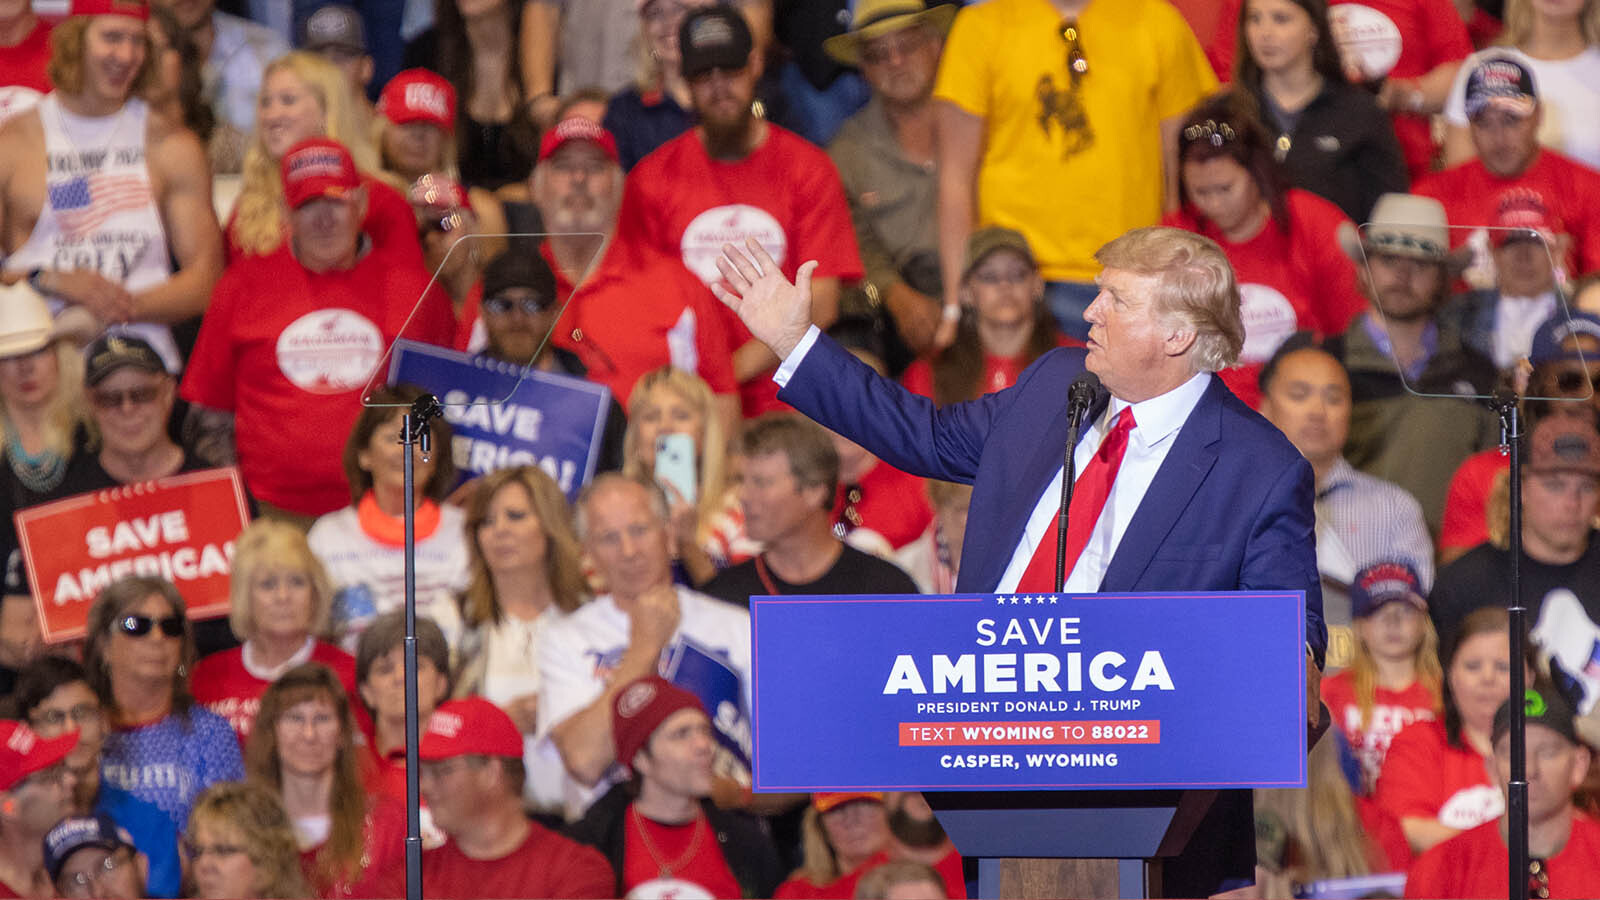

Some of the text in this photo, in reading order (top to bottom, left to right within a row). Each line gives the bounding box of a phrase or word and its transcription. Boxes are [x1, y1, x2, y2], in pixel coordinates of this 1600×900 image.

[444, 389, 543, 443] SAVE
[86, 509, 190, 560] SAVE
[976, 617, 1081, 647] SAVE
[882, 650, 1176, 695] AMERICA
[917, 699, 1141, 714] PRESIDENT DONALD J. TRUMP
[910, 724, 1149, 741] TEXT WYOMING TO 88022
[940, 752, 1118, 770] CASPER, WYOMING
